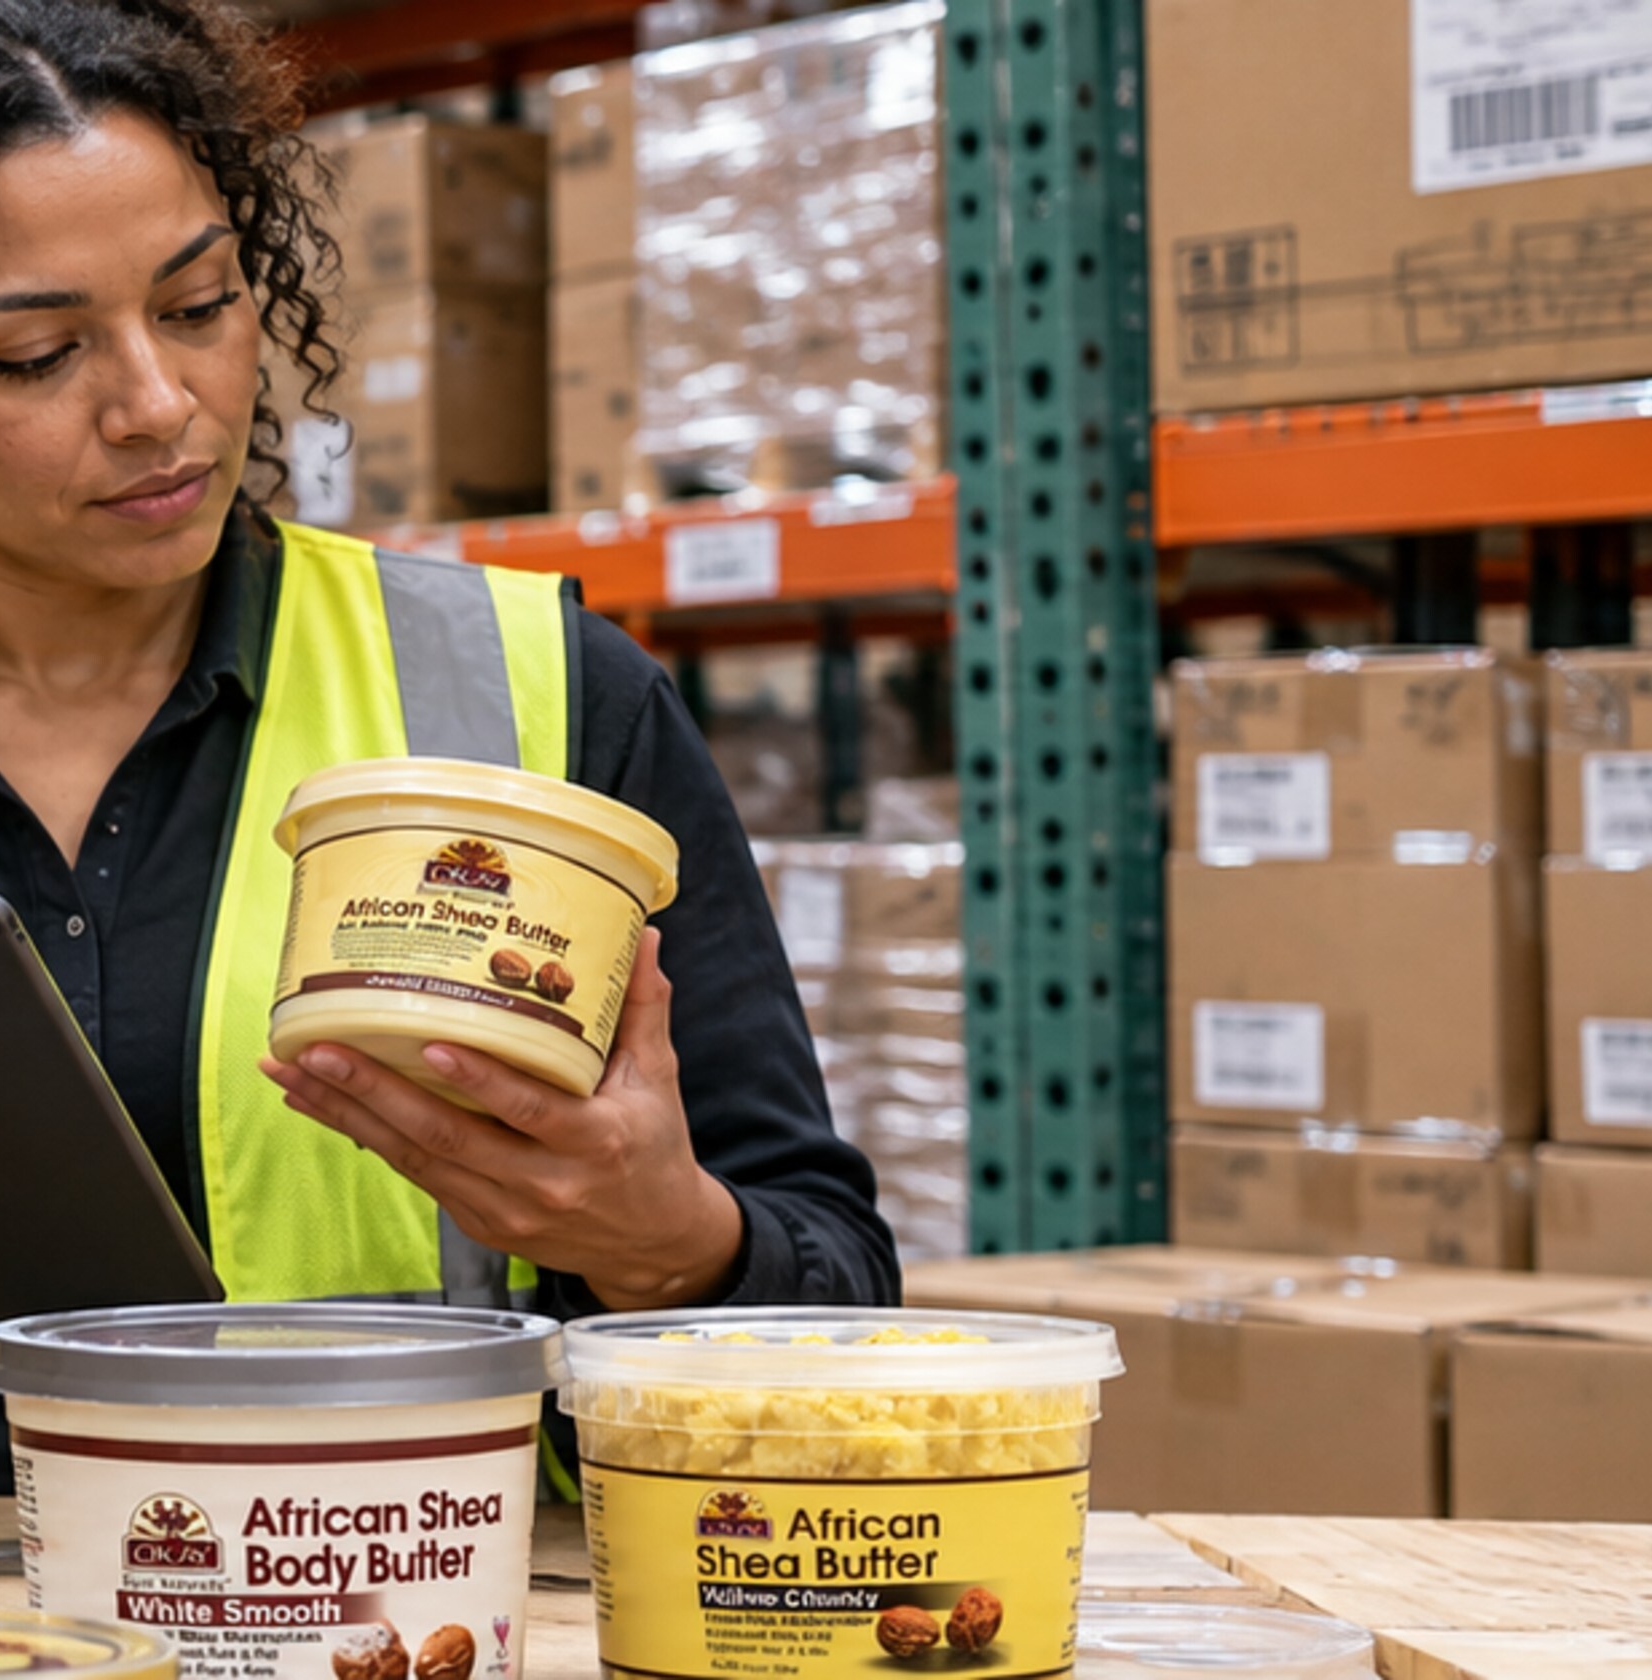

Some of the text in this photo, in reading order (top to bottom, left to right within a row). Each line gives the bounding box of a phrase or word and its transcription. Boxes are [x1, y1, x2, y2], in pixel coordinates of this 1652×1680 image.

[241, 1490, 503, 1538] African Shea
[787, 1508, 940, 1541] African
[246, 1543, 358, 1593] Body
[367, 1540, 475, 1586] Butter
[696, 1545, 939, 1580] Shea Butter
[126, 1597, 342, 1625] White Smooth
